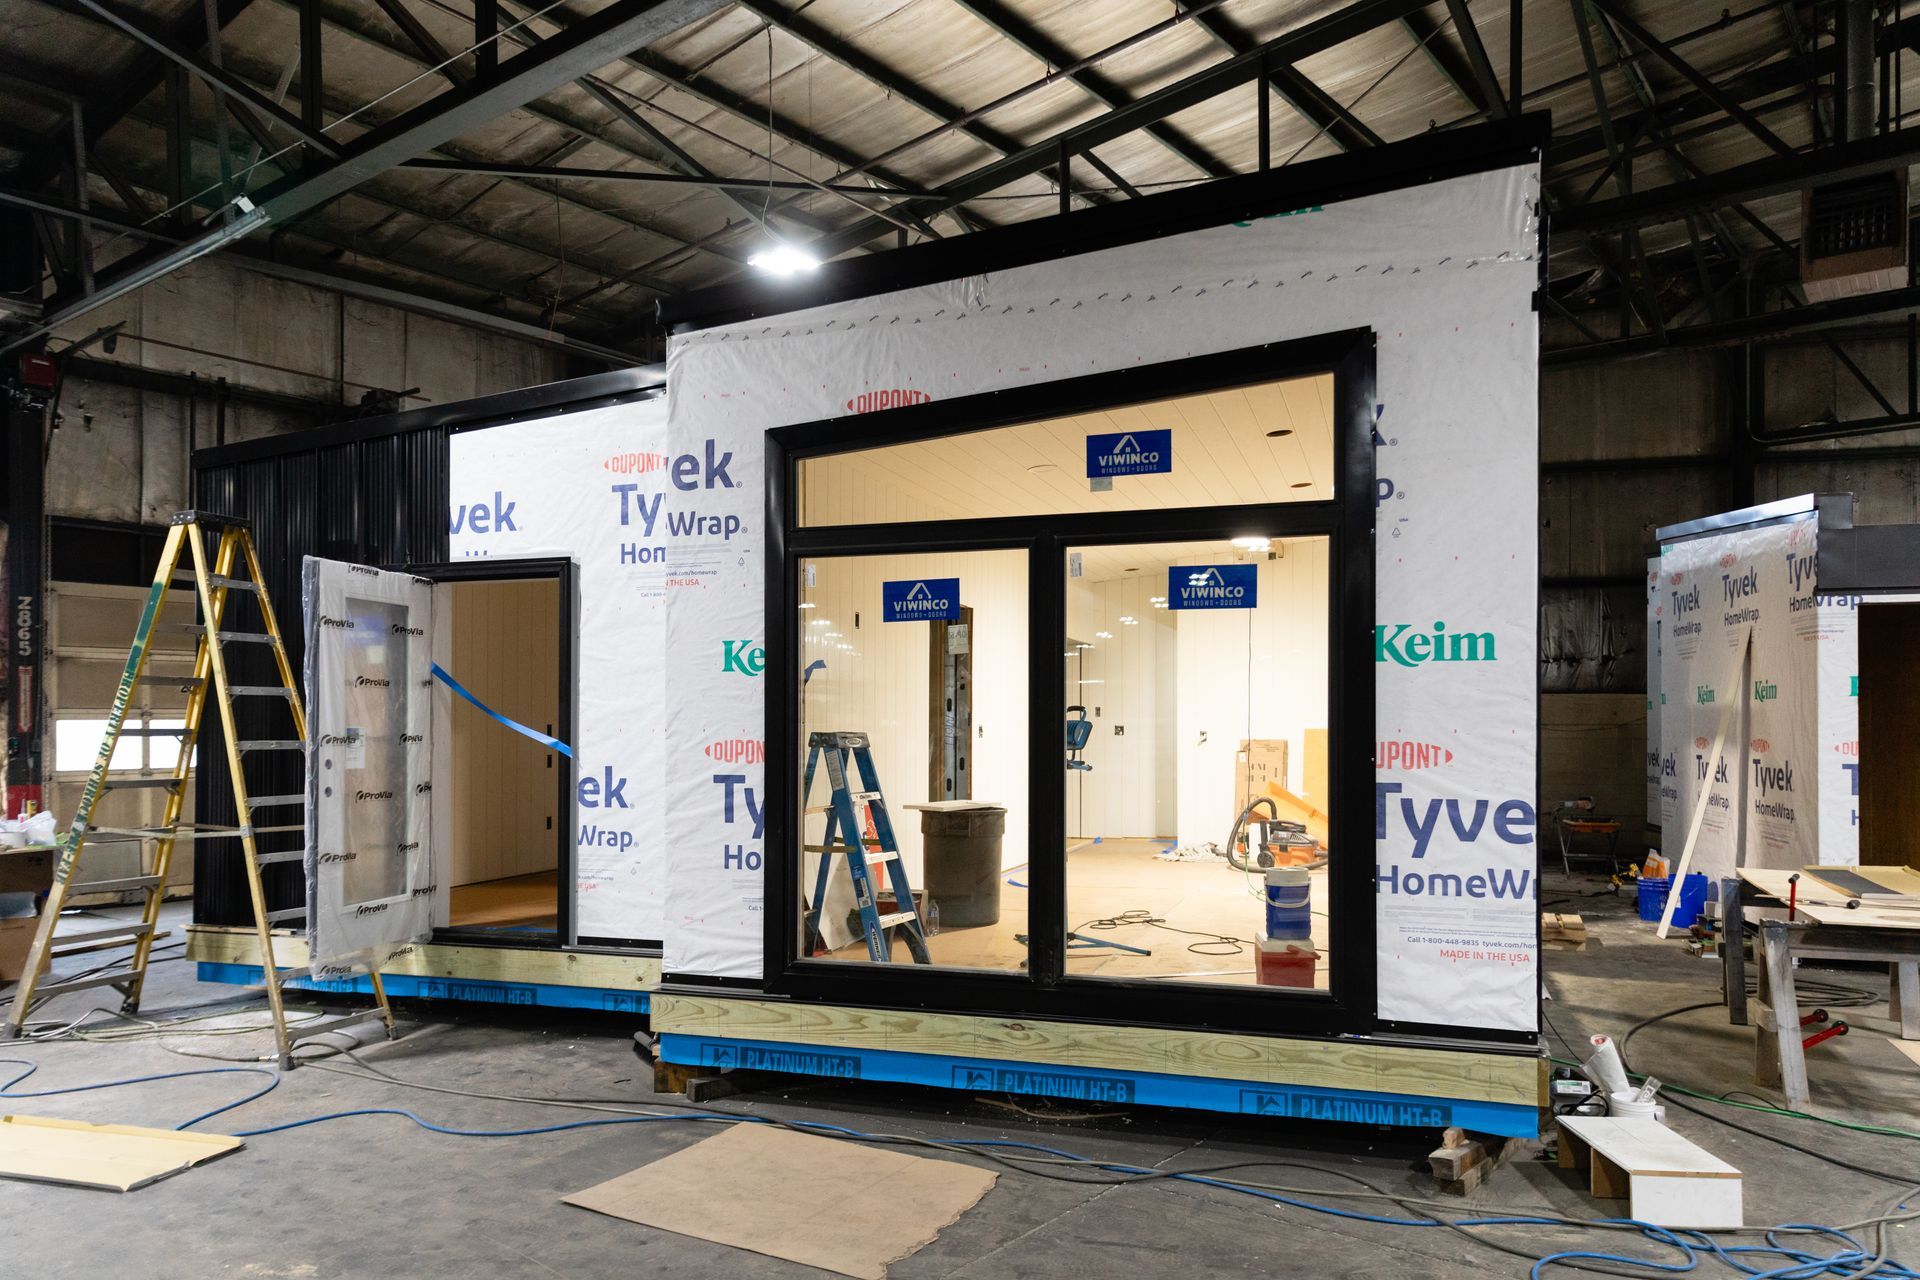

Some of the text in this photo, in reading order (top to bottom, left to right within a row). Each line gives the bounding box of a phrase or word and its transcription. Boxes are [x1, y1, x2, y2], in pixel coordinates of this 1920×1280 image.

[612, 452, 661, 473] DUPONT
[668, 439, 735, 491] ek
[1099, 452, 1159, 466] VIWINCO
[1101, 466, 1130, 474] WINDOWS
[612, 483, 665, 537] Ty
[668, 511, 740, 540] Wrap
[1181, 586, 1244, 599] VIWINCO
[1722, 566, 1758, 608] Tyvek
[894, 599, 949, 612] VIWINCO
[1672, 584, 1700, 621] Tyvek
[327, 619, 354, 629] ProVia
[1724, 608, 1759, 627] HomeWrap
[400, 627, 424, 636] ProVia
[1673, 622, 1701, 637] HomeWrap
[1376, 621, 1497, 667] Keim
[365, 678, 390, 687] ProVia
[1755, 680, 1777, 702] Keim
[1697, 685, 1715, 705] Keim
[1696, 755, 1728, 784] Tyek
[1752, 759, 1793, 796] Tyvek
[363, 791, 392, 800] ProVia
[1376, 782, 1536, 858] Tyve
[1755, 800, 1795, 823] HomeWrap
[363, 903, 388, 914] ProVia
[1422, 937, 1479, 946] 1-800-448-9835
[1440, 949, 1530, 963] MADE IN THE USA
[453, 985, 533, 1005] PLATINUM HT-B
[747, 1050, 854, 1077] PLATINUM HT-B
[1004, 1073, 1127, 1102] PLATINUM HT-B
[1301, 1097, 1443, 1127] PLATINUM HT-B
